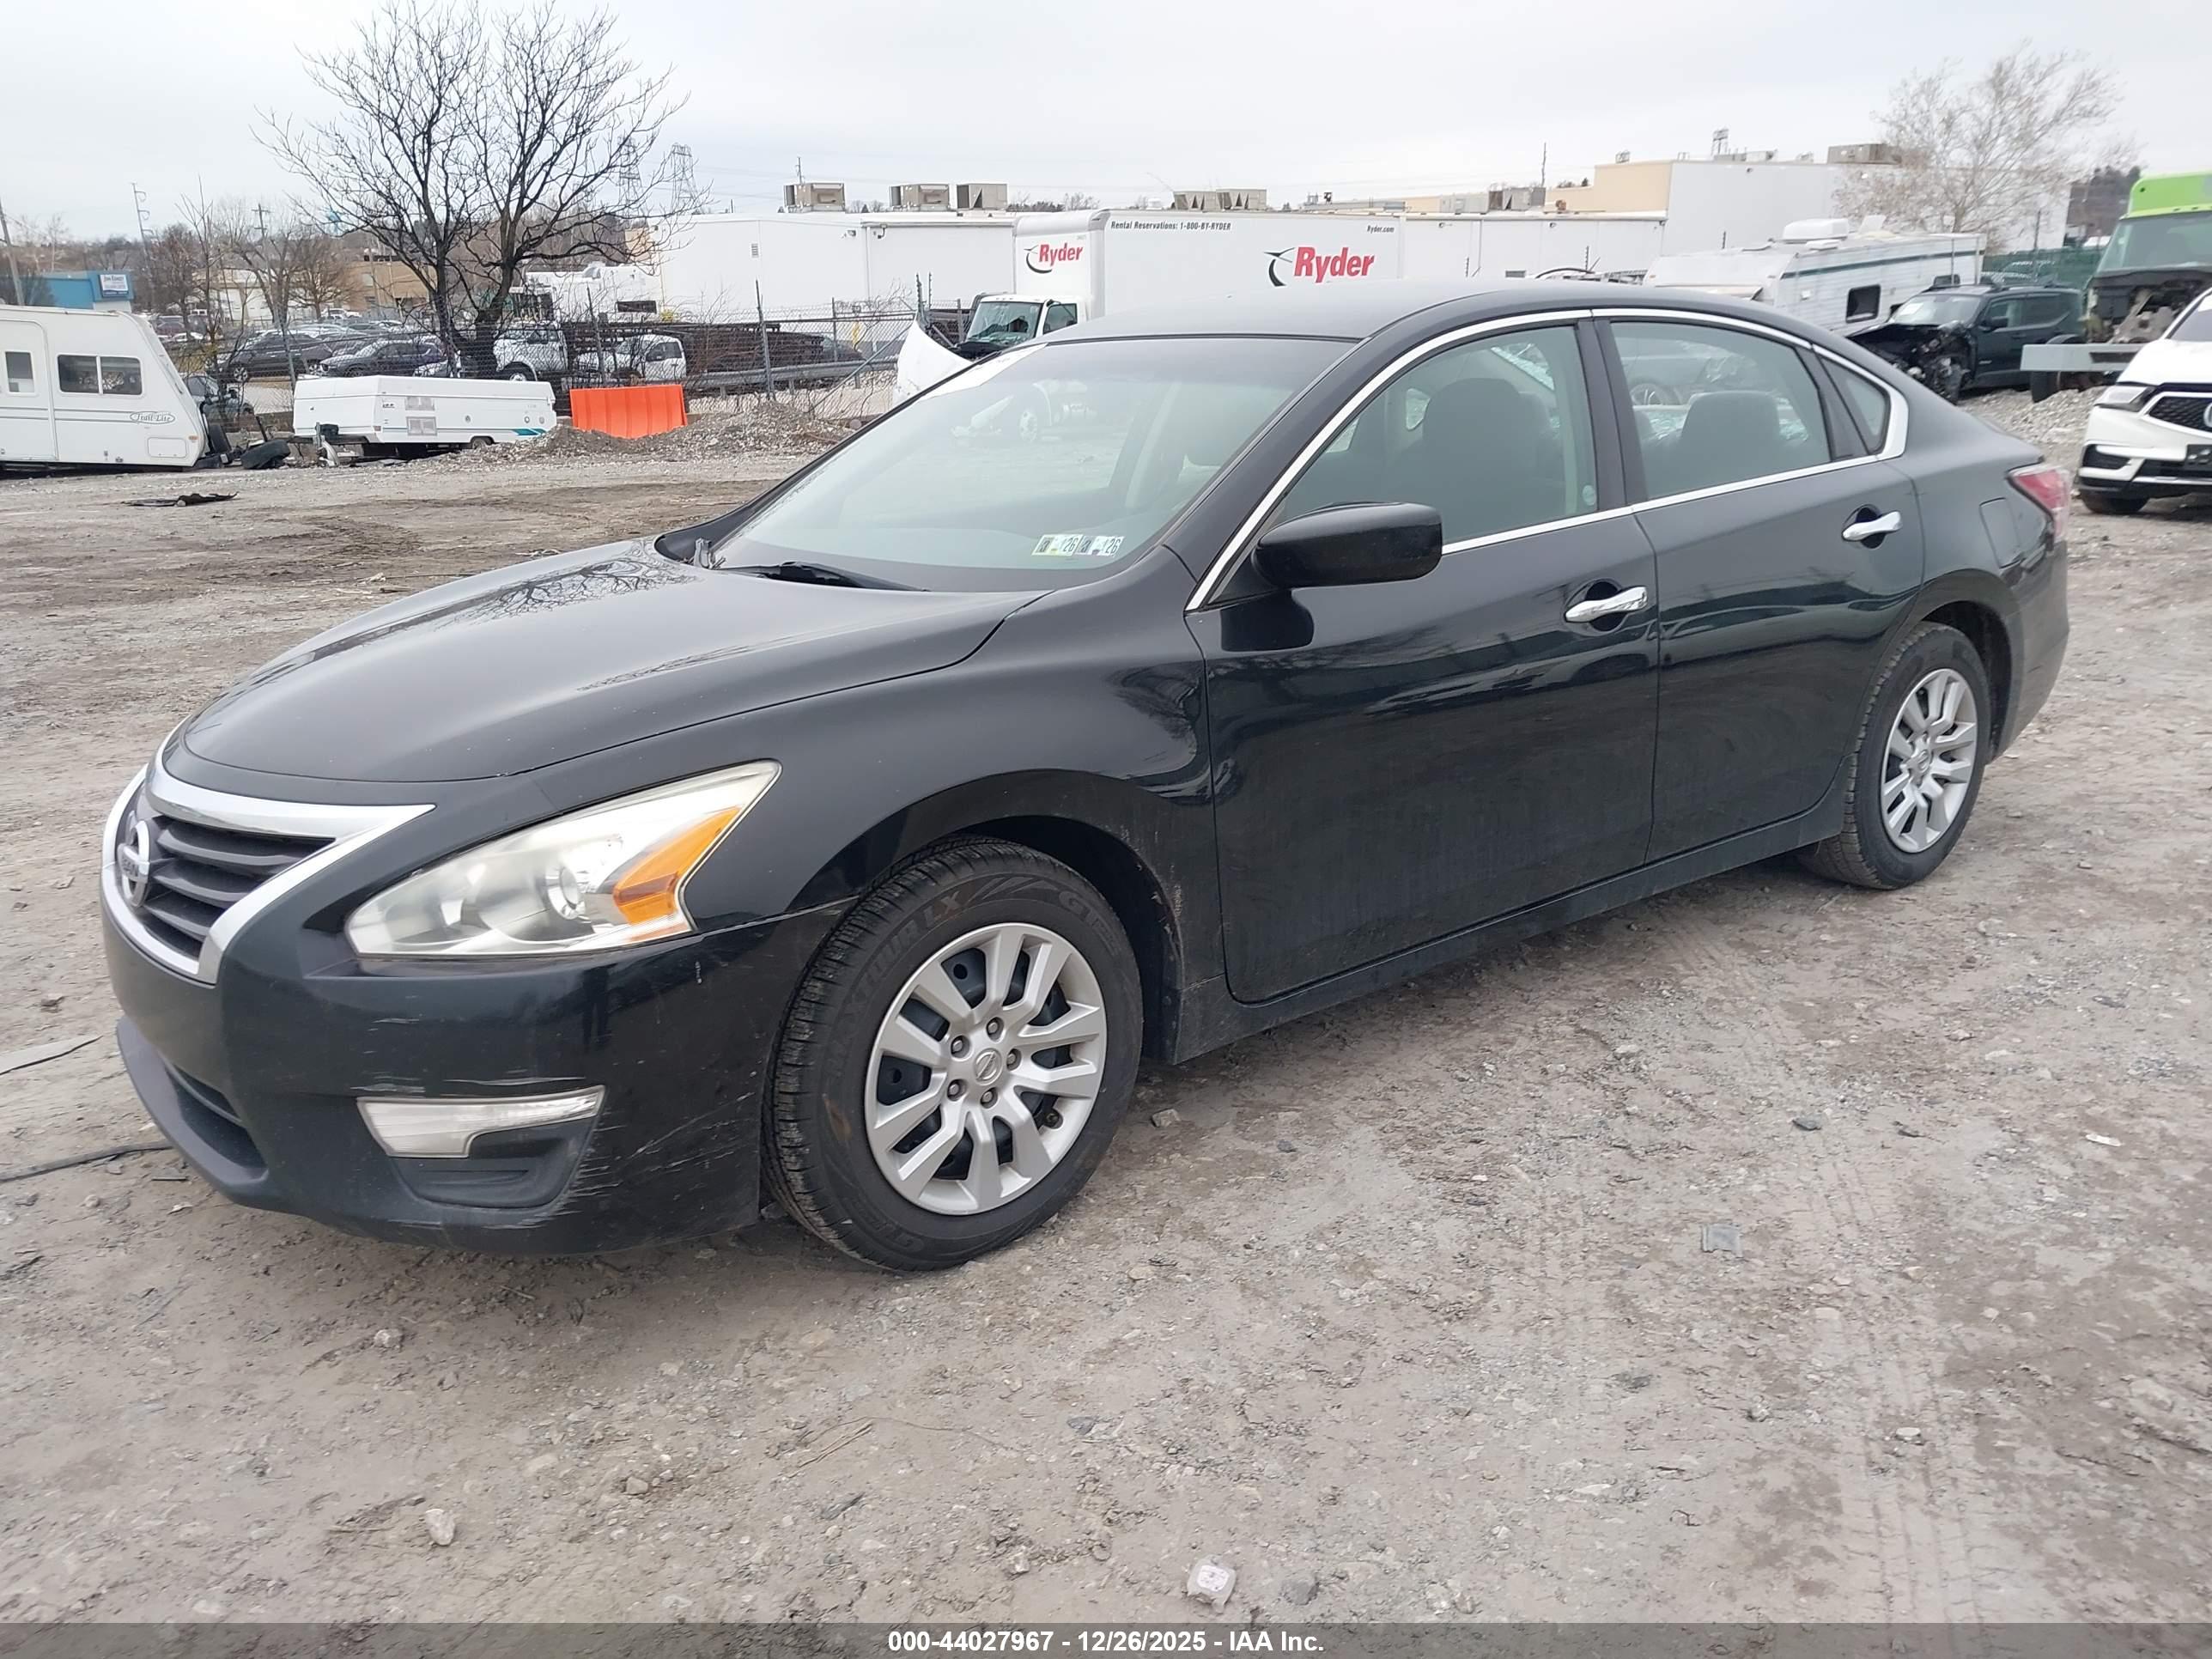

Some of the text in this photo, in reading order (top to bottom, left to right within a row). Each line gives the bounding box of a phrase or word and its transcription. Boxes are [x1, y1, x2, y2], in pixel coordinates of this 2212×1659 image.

[1111, 221, 1231, 230] Rental Reservations: 1-800-BY-RYDER
[1366, 225, 1395, 234] Ryder.com
[1038, 242, 1084, 267] Ryder
[1293, 246, 1376, 284] Ryder
